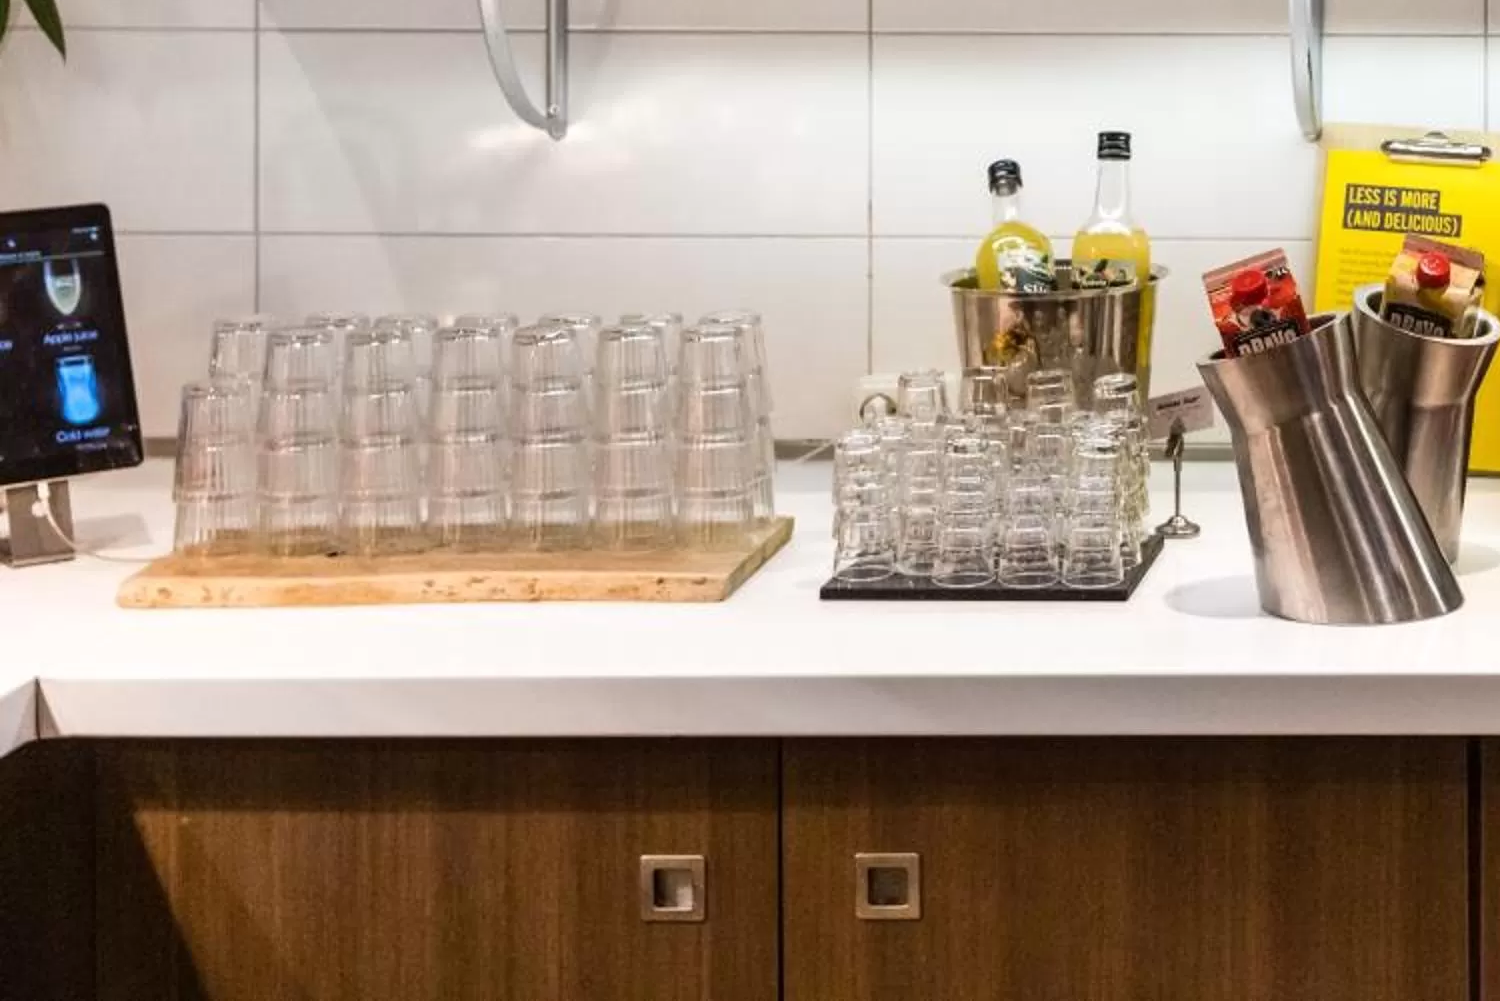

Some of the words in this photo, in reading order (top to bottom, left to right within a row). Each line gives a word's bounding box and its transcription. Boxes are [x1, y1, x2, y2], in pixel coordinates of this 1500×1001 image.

[1348, 185, 1381, 205] LESS
[1383, 188, 1398, 207] IS
[1400, 189, 1439, 210] MORE
[1346, 206, 1381, 229] (AND
[1383, 211, 1459, 236] DELICIOUS)
